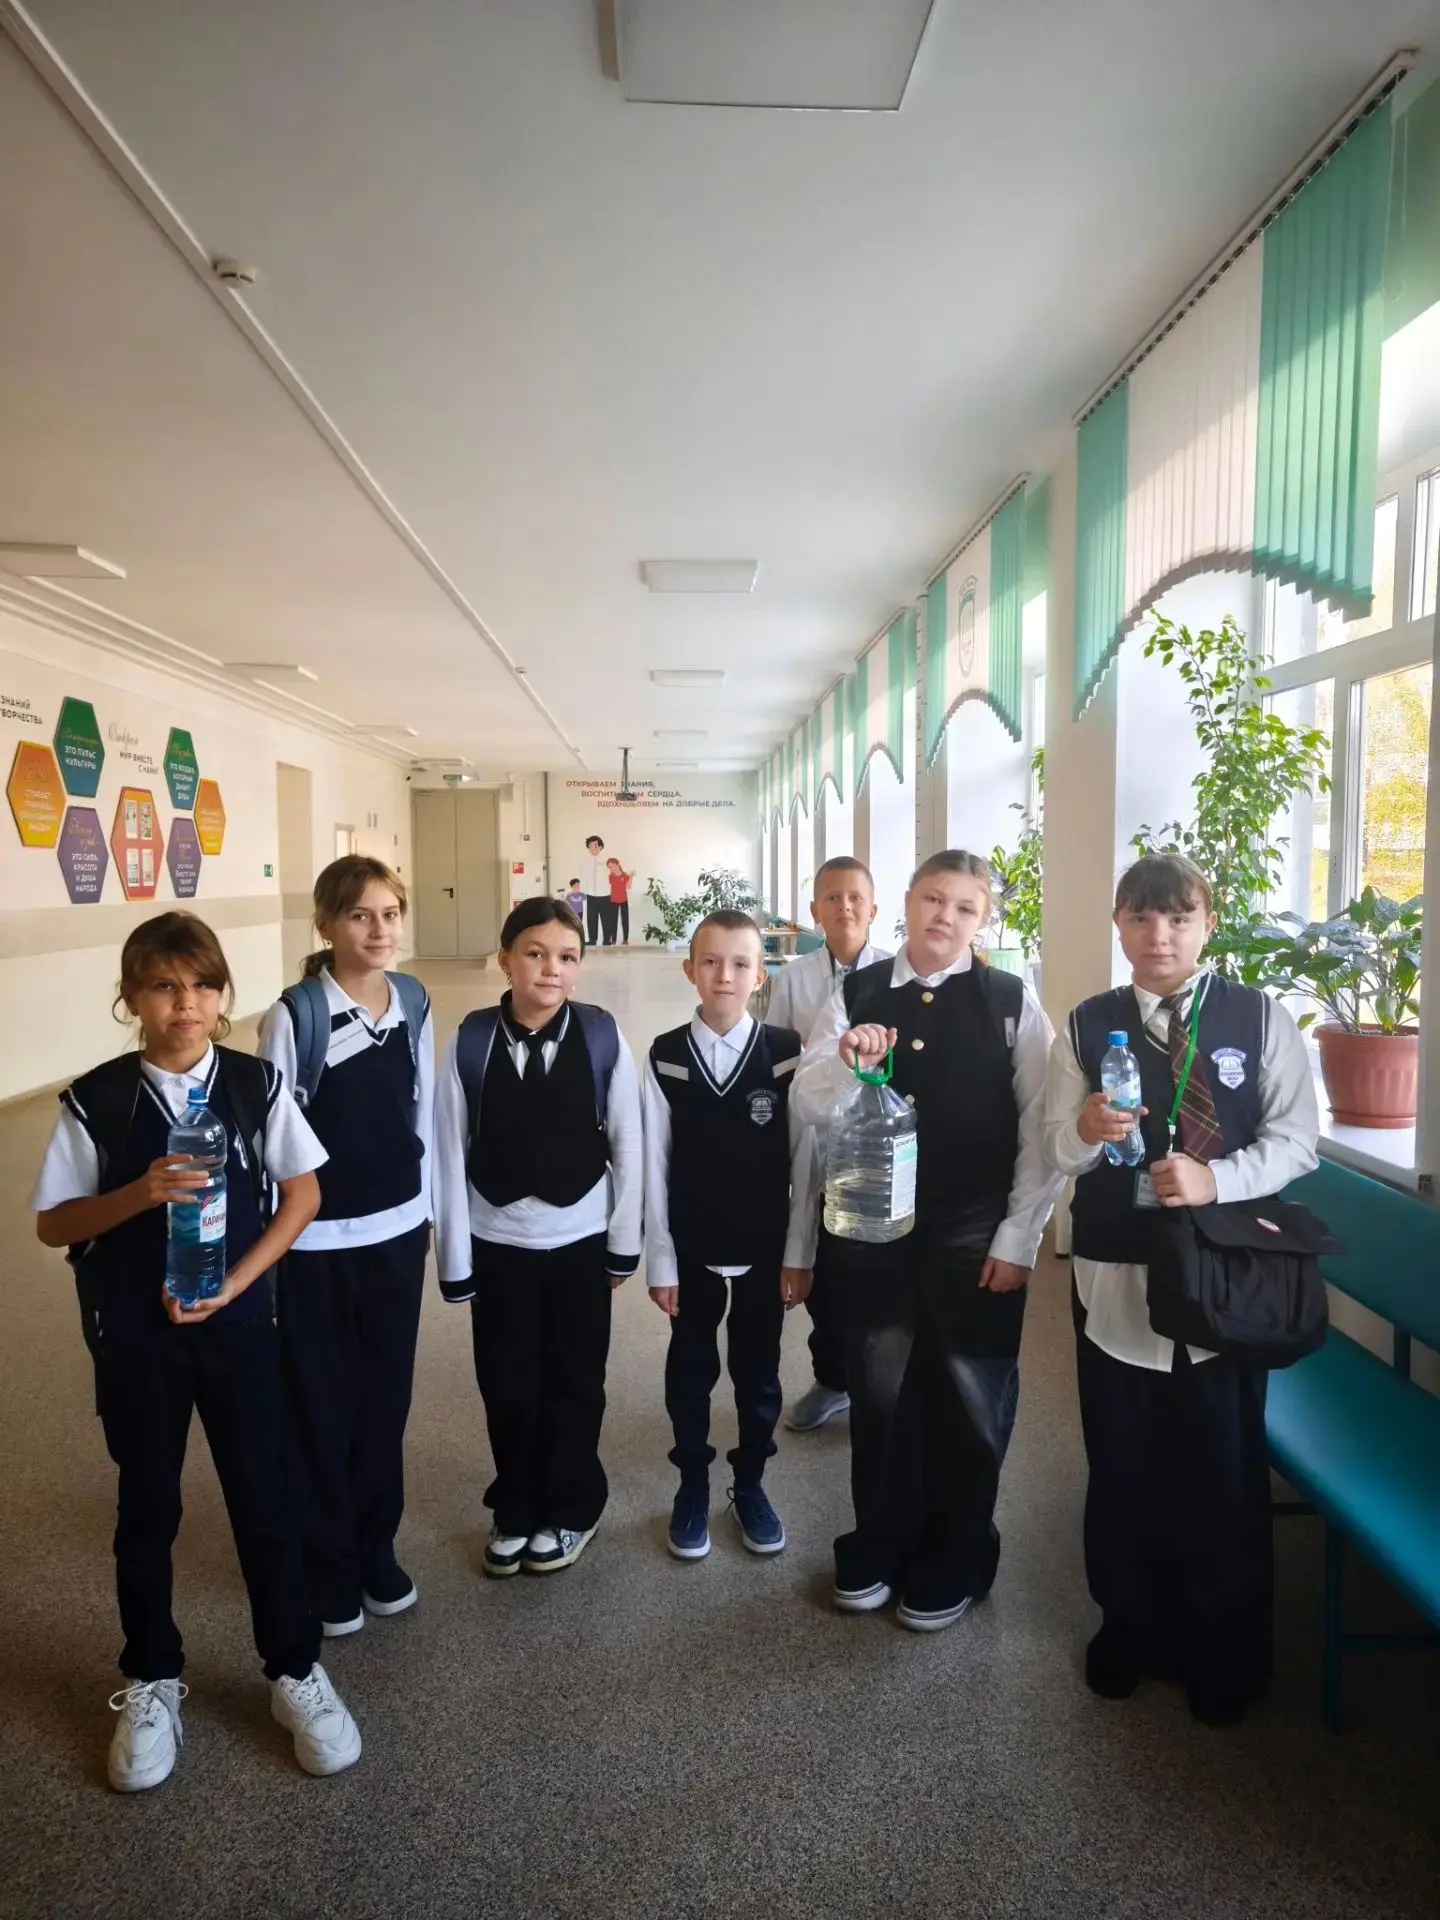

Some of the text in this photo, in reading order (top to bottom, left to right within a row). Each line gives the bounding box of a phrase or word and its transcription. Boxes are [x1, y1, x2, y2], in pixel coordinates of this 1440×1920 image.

[1, 695, 31, 710] ЗНАНИЙ
[0, 708, 43, 725] ВОРЧЕСТВА
[64, 745, 77, 755] ЭТО
[566, 780, 617, 788] ОТКРЫВАЕМ
[597, 800, 659, 808] ВДОХНОВЛЯЕМ
[676, 800, 711, 808] ДОБРЫЕ
[71, 853, 82, 861] ЭТО
[73, 863, 98, 871] КРАСОТА
[75, 884, 98, 892] НАРОДА
